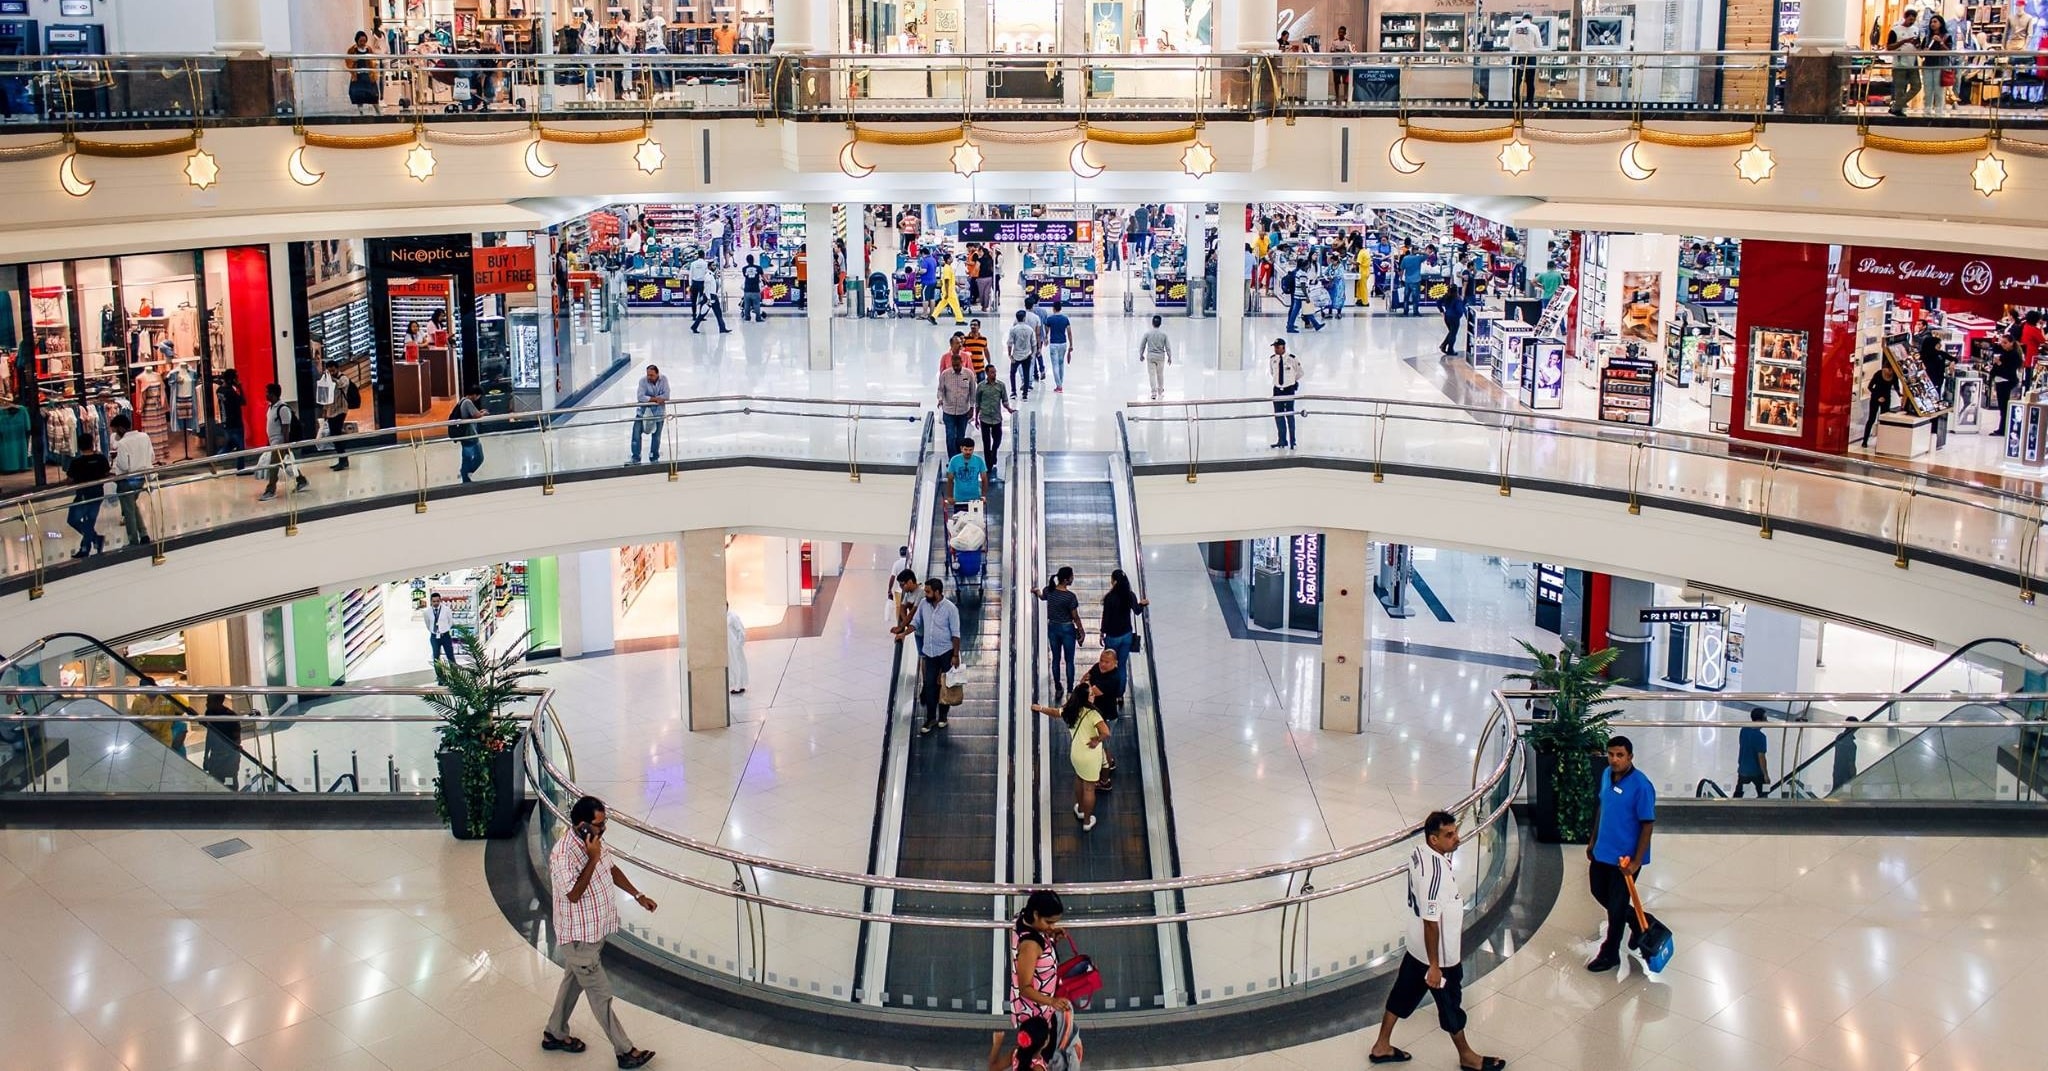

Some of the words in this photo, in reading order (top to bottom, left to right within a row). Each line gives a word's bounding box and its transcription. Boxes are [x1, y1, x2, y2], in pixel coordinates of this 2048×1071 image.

[487, 256, 508, 268] BUY
[512, 254, 517, 266] 1
[475, 271, 495, 284] GET
[496, 270, 502, 283] 1
[506, 269, 533, 283] FREE
[1857, 257, 1895, 275] Paris
[1898, 260, 1955, 287] Gallery
[429, 284, 446, 292] FREE
[1306, 574, 1317, 605] DUBAI
